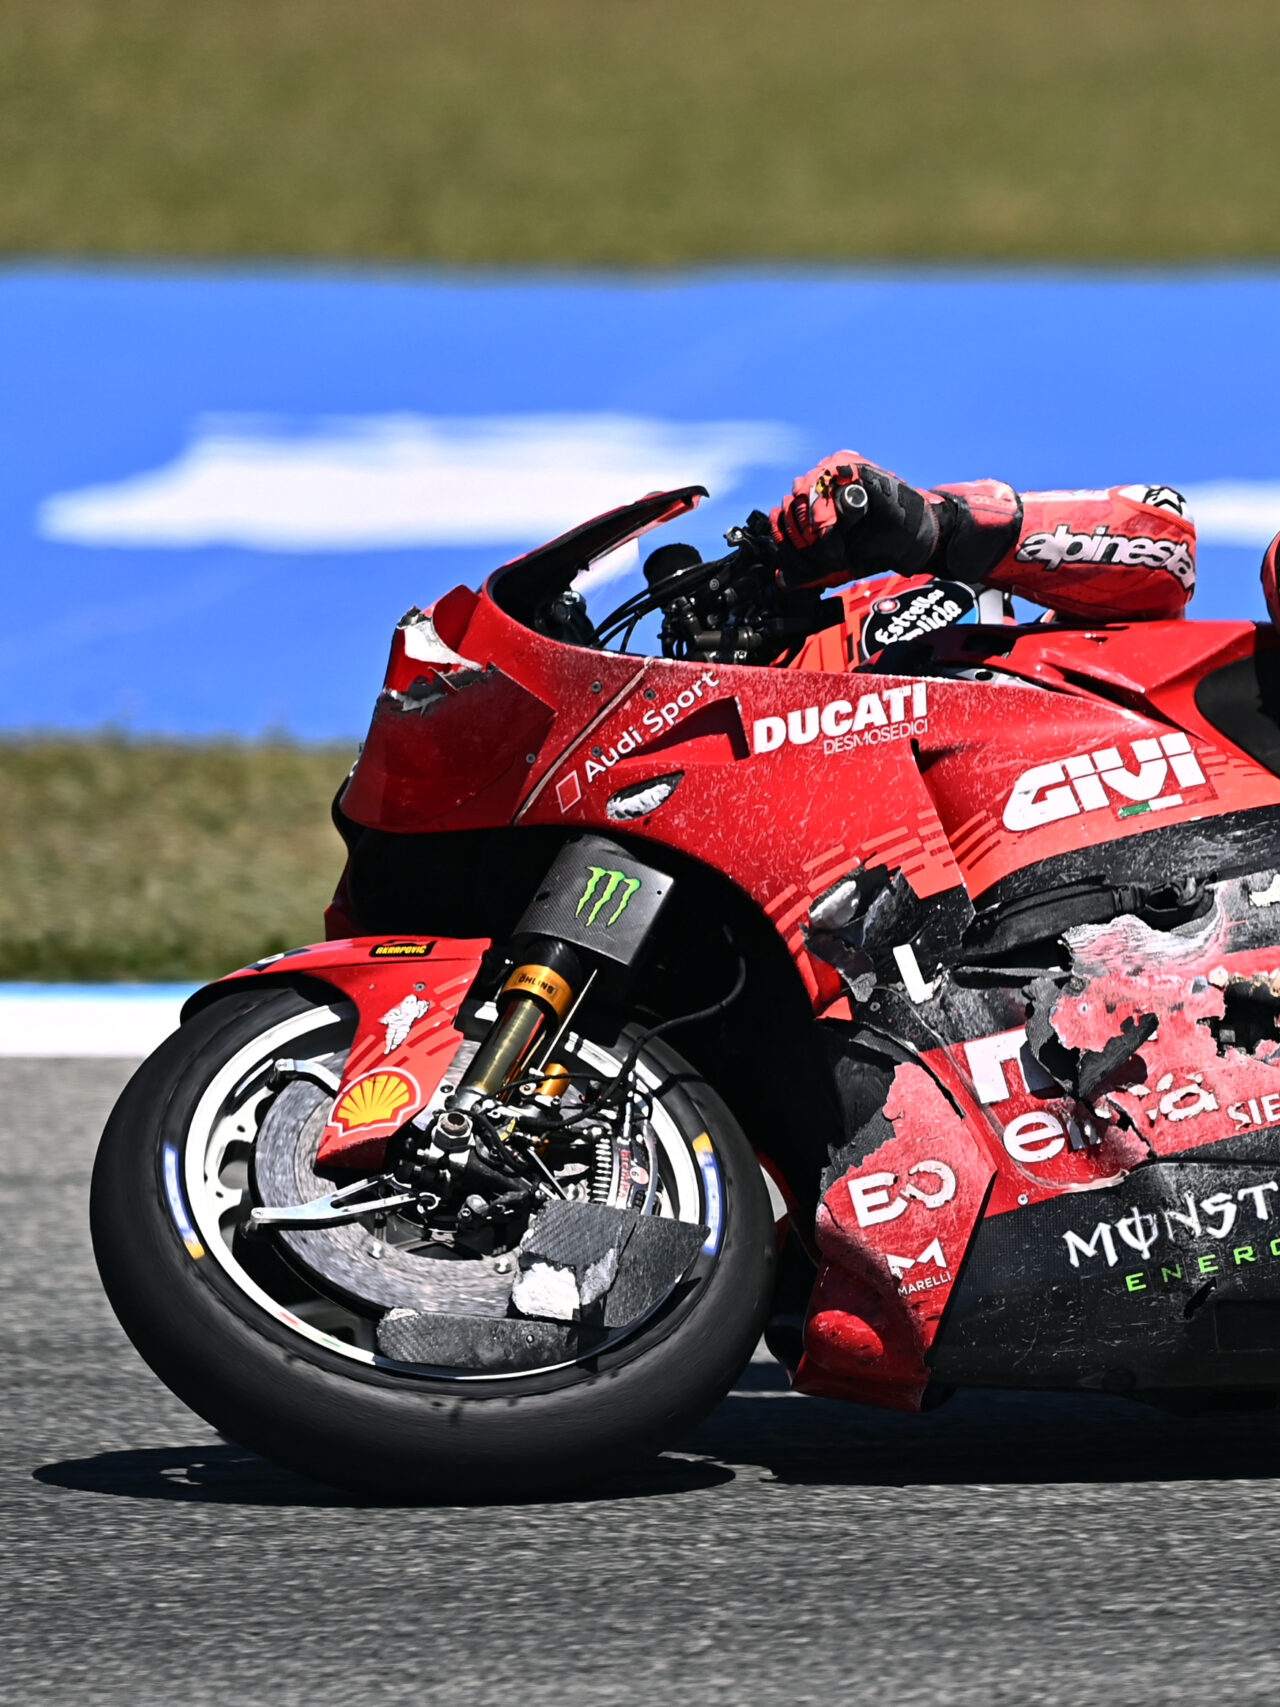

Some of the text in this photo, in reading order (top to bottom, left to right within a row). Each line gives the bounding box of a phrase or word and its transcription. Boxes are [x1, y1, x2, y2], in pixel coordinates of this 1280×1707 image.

[583, 670, 721, 784] Audi Sport
[753, 682, 928, 755] DUCATI
[823, 717, 928, 755] DESMOSEDICI
[1001, 731, 1207, 832] GIVI
[897, 1270, 953, 1297] MARELLI
